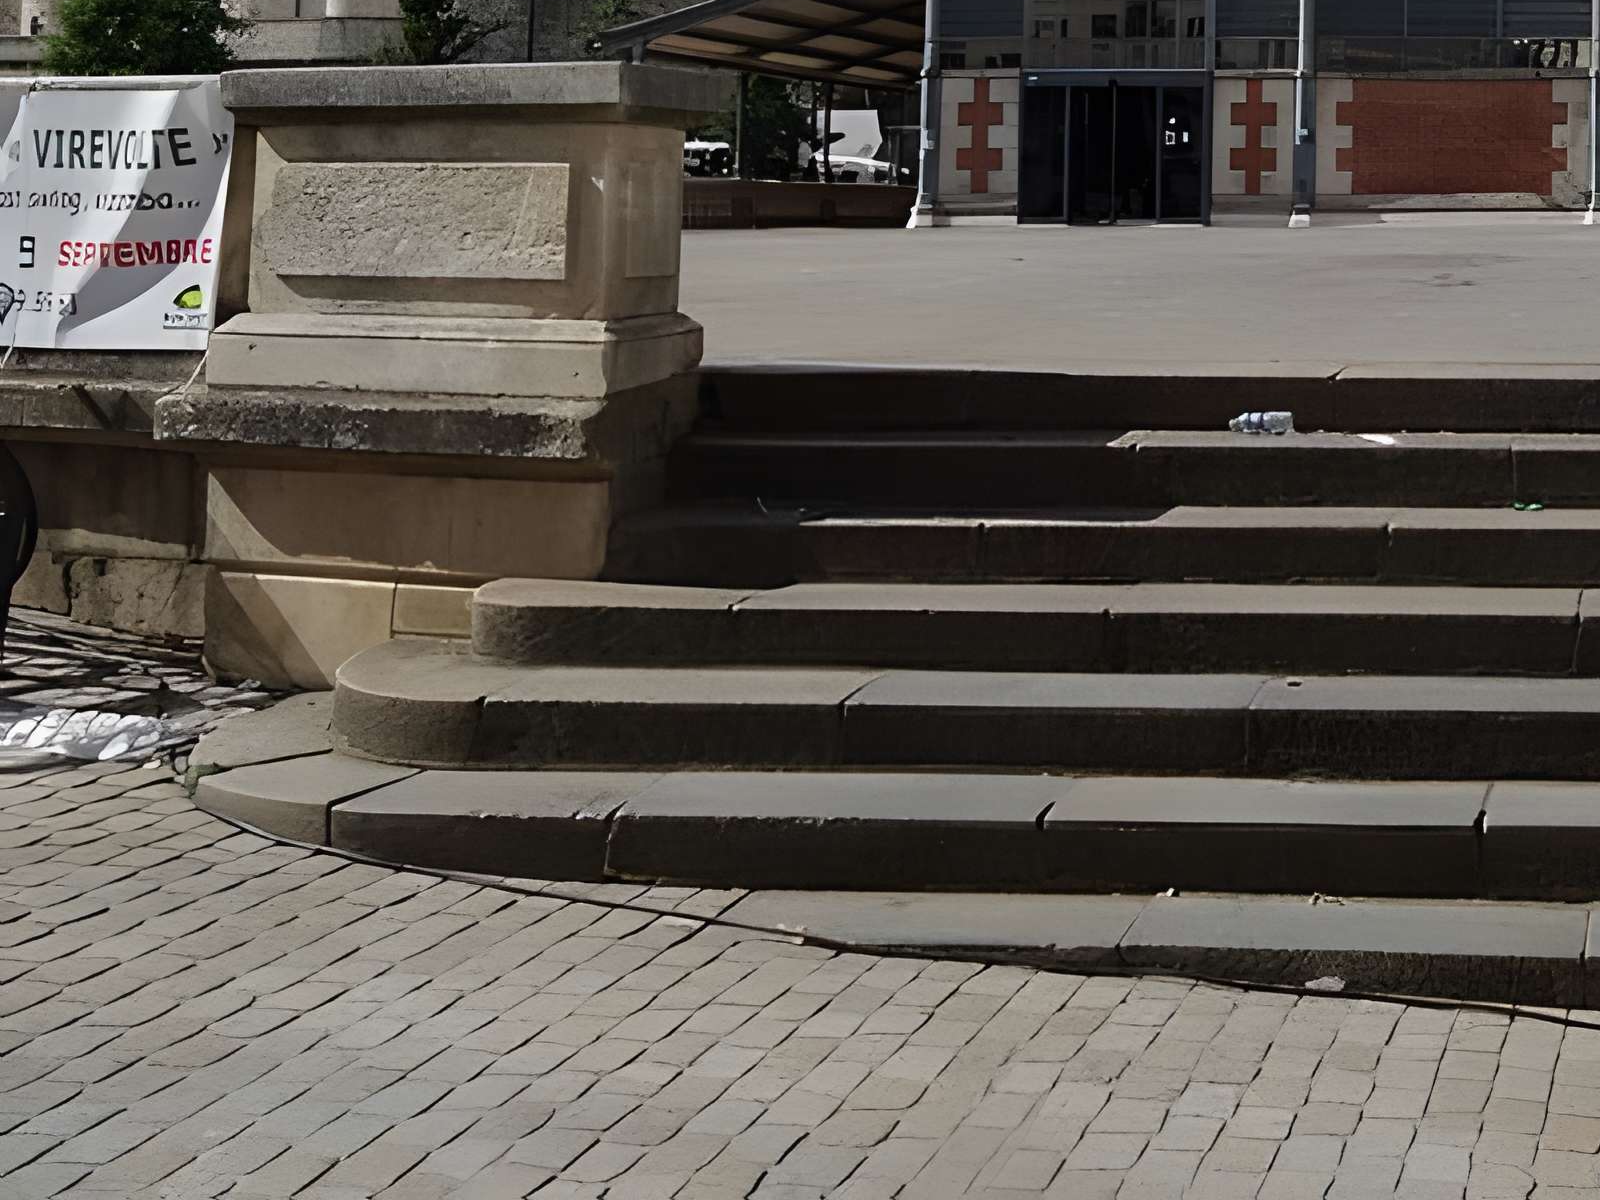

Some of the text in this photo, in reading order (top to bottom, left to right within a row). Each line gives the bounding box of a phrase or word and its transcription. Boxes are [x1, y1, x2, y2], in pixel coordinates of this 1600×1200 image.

[33, 128, 197, 169] VIREVOLTE
[19, 236, 212, 268] 9 SEPTEMBRE
